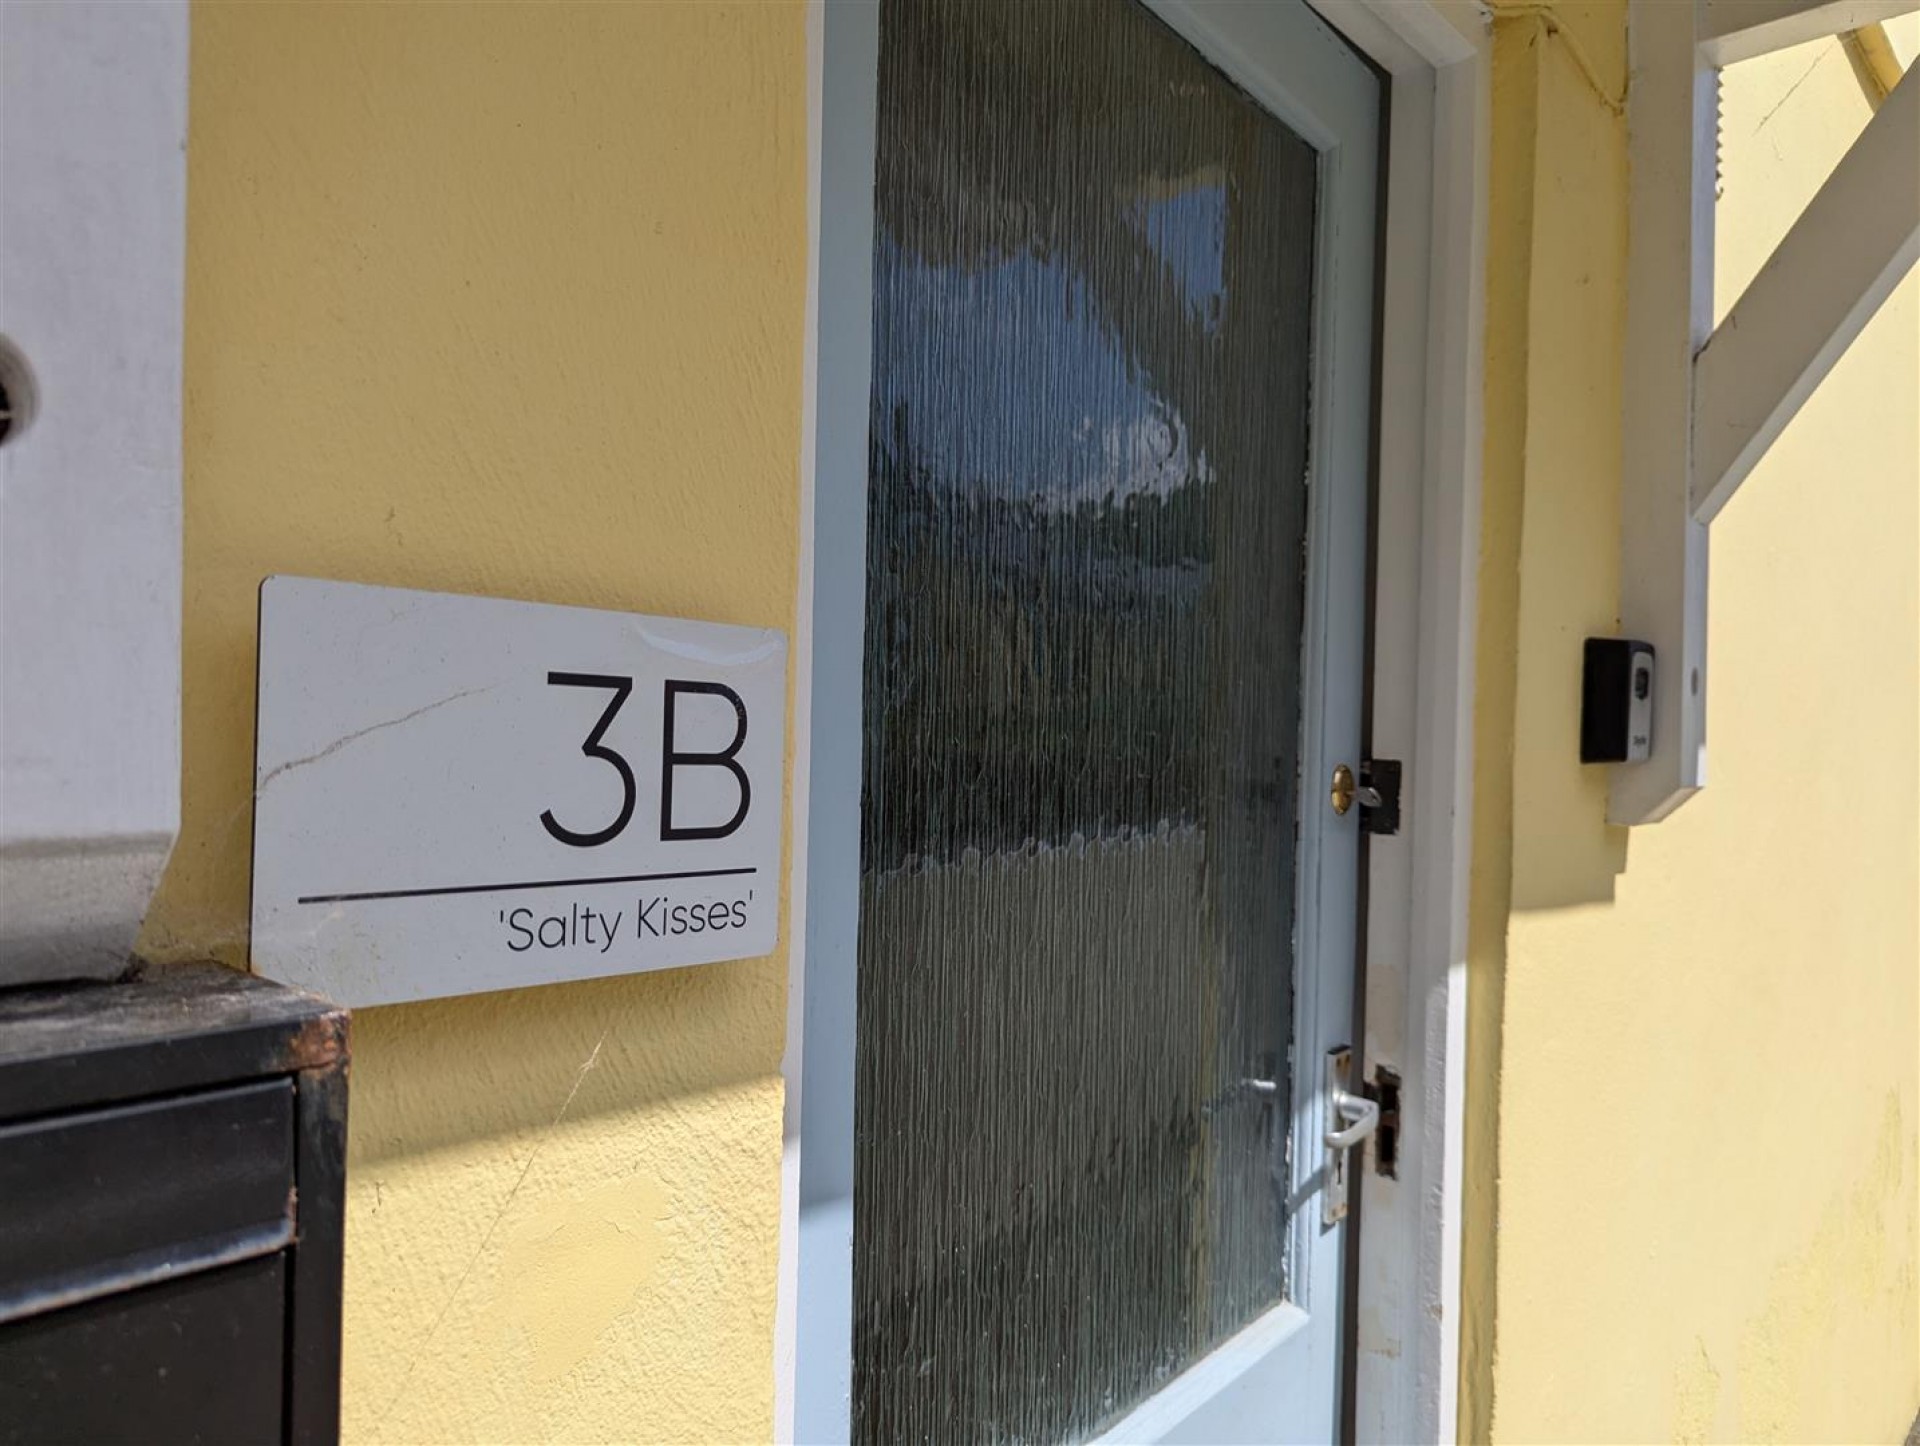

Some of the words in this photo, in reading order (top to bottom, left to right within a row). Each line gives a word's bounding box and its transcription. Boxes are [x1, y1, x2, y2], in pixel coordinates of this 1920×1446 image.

[540, 671, 751, 847] 3B
[500, 902, 622, 953] 'Salty
[637, 889, 753, 939] Kisses'
